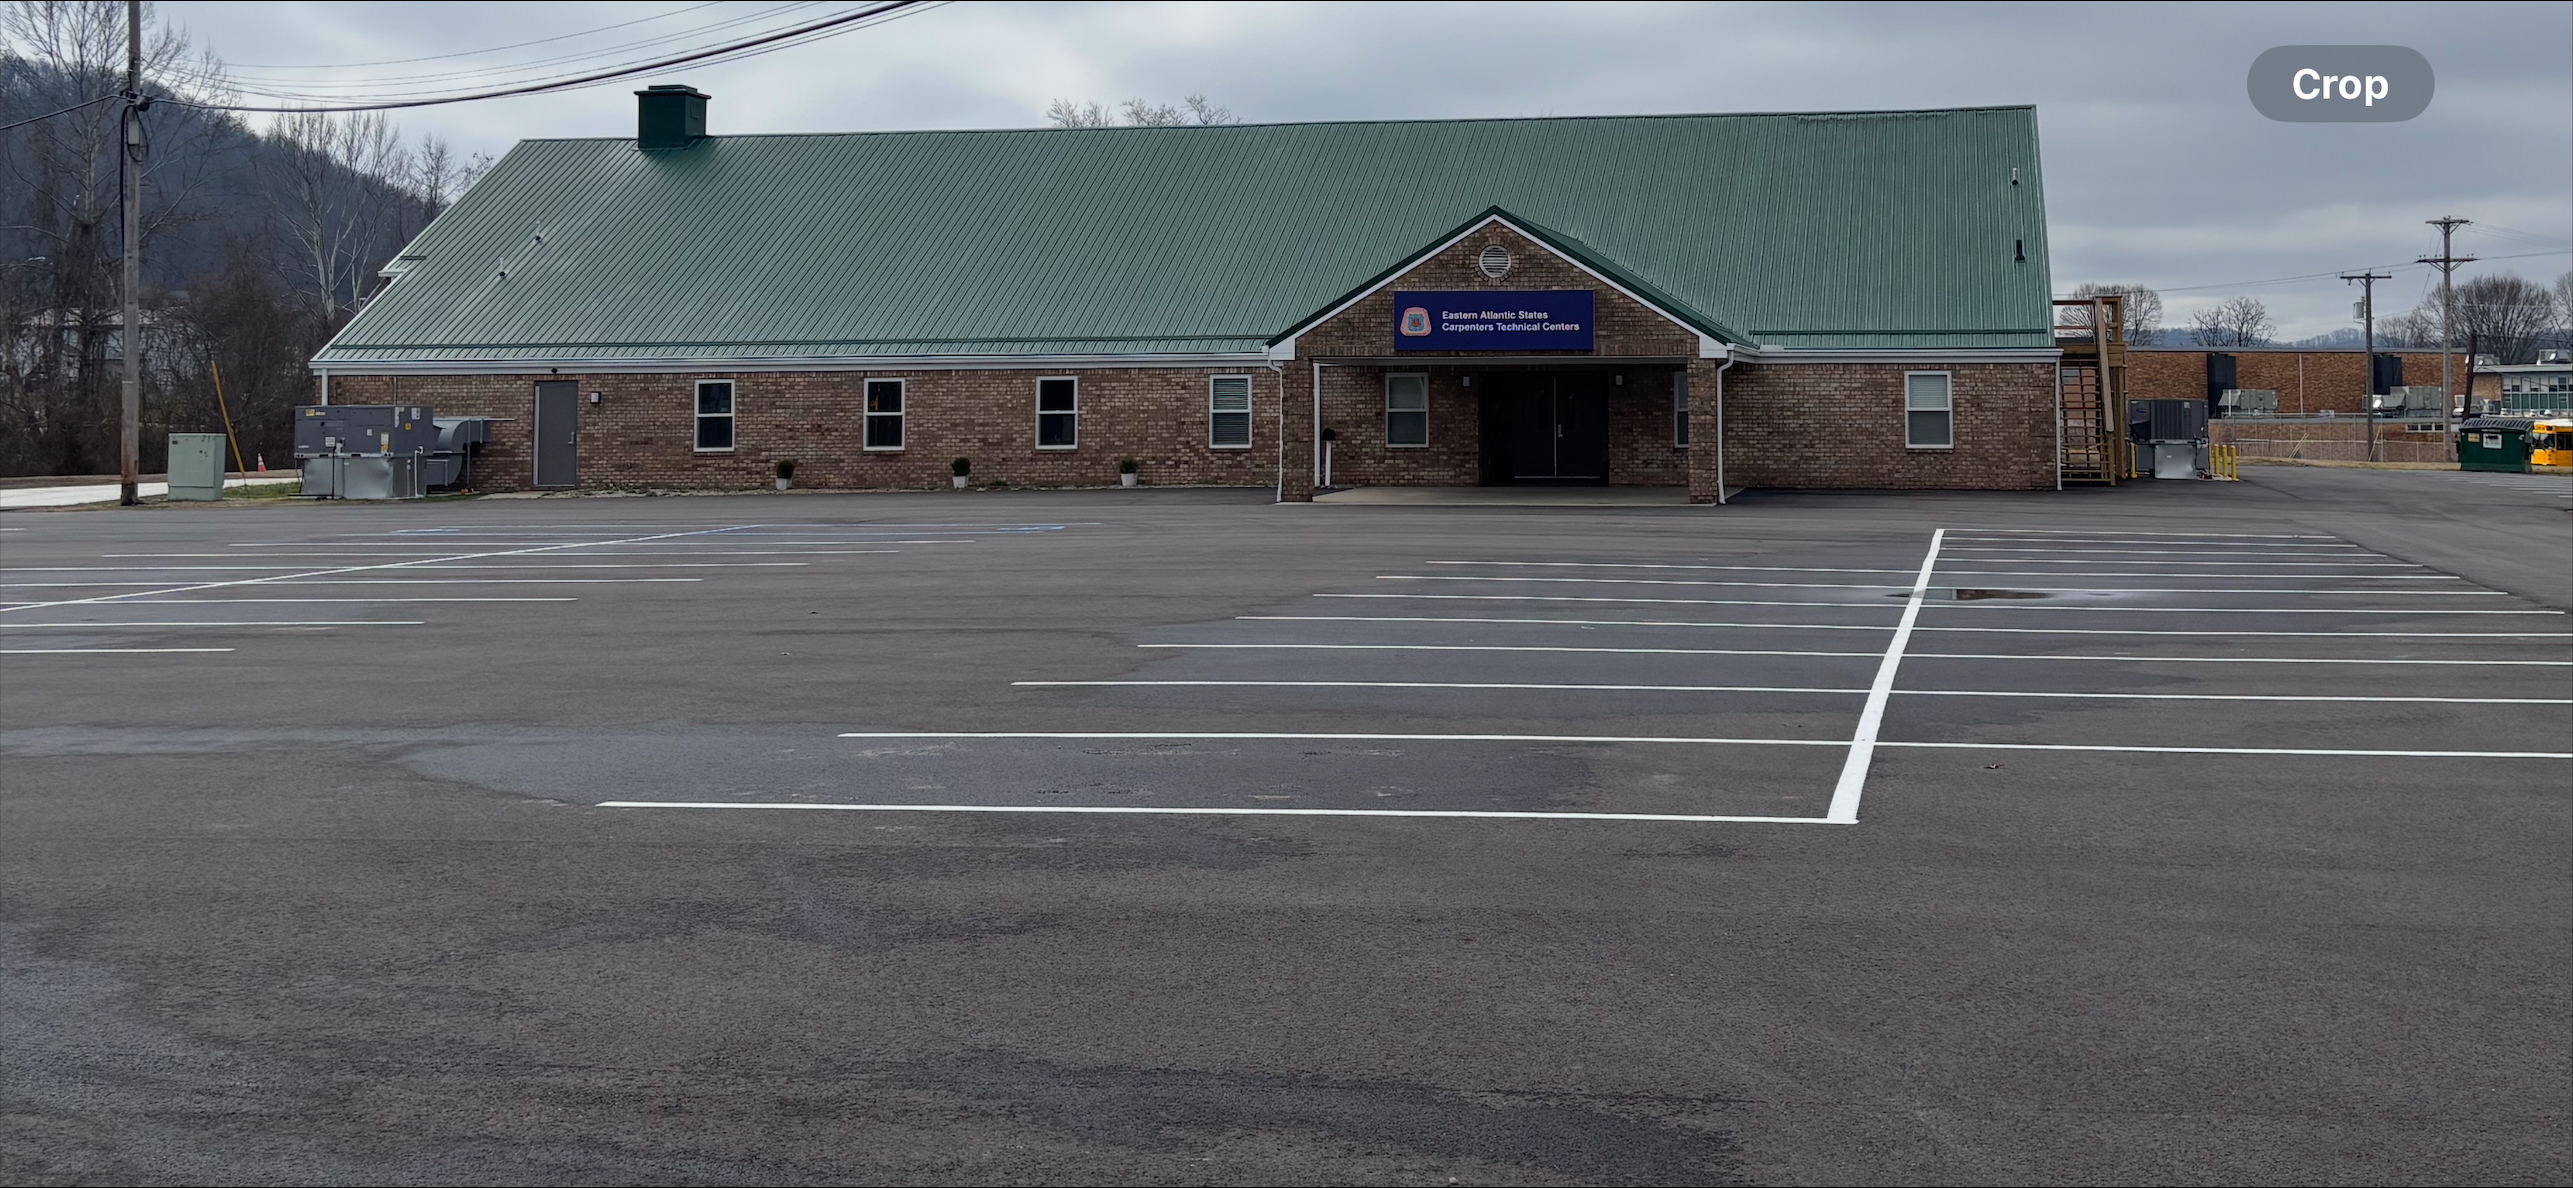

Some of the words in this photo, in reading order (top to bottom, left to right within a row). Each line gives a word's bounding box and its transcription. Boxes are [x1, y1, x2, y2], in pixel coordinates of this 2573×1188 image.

[1442, 310, 1478, 320] Eastern
[1480, 310, 1516, 320] Atlantic
[1518, 310, 1549, 320] States
[1441, 322, 1494, 333] Carpenters
[1496, 322, 1541, 332] Technical
[1542, 322, 1580, 332] Centers
